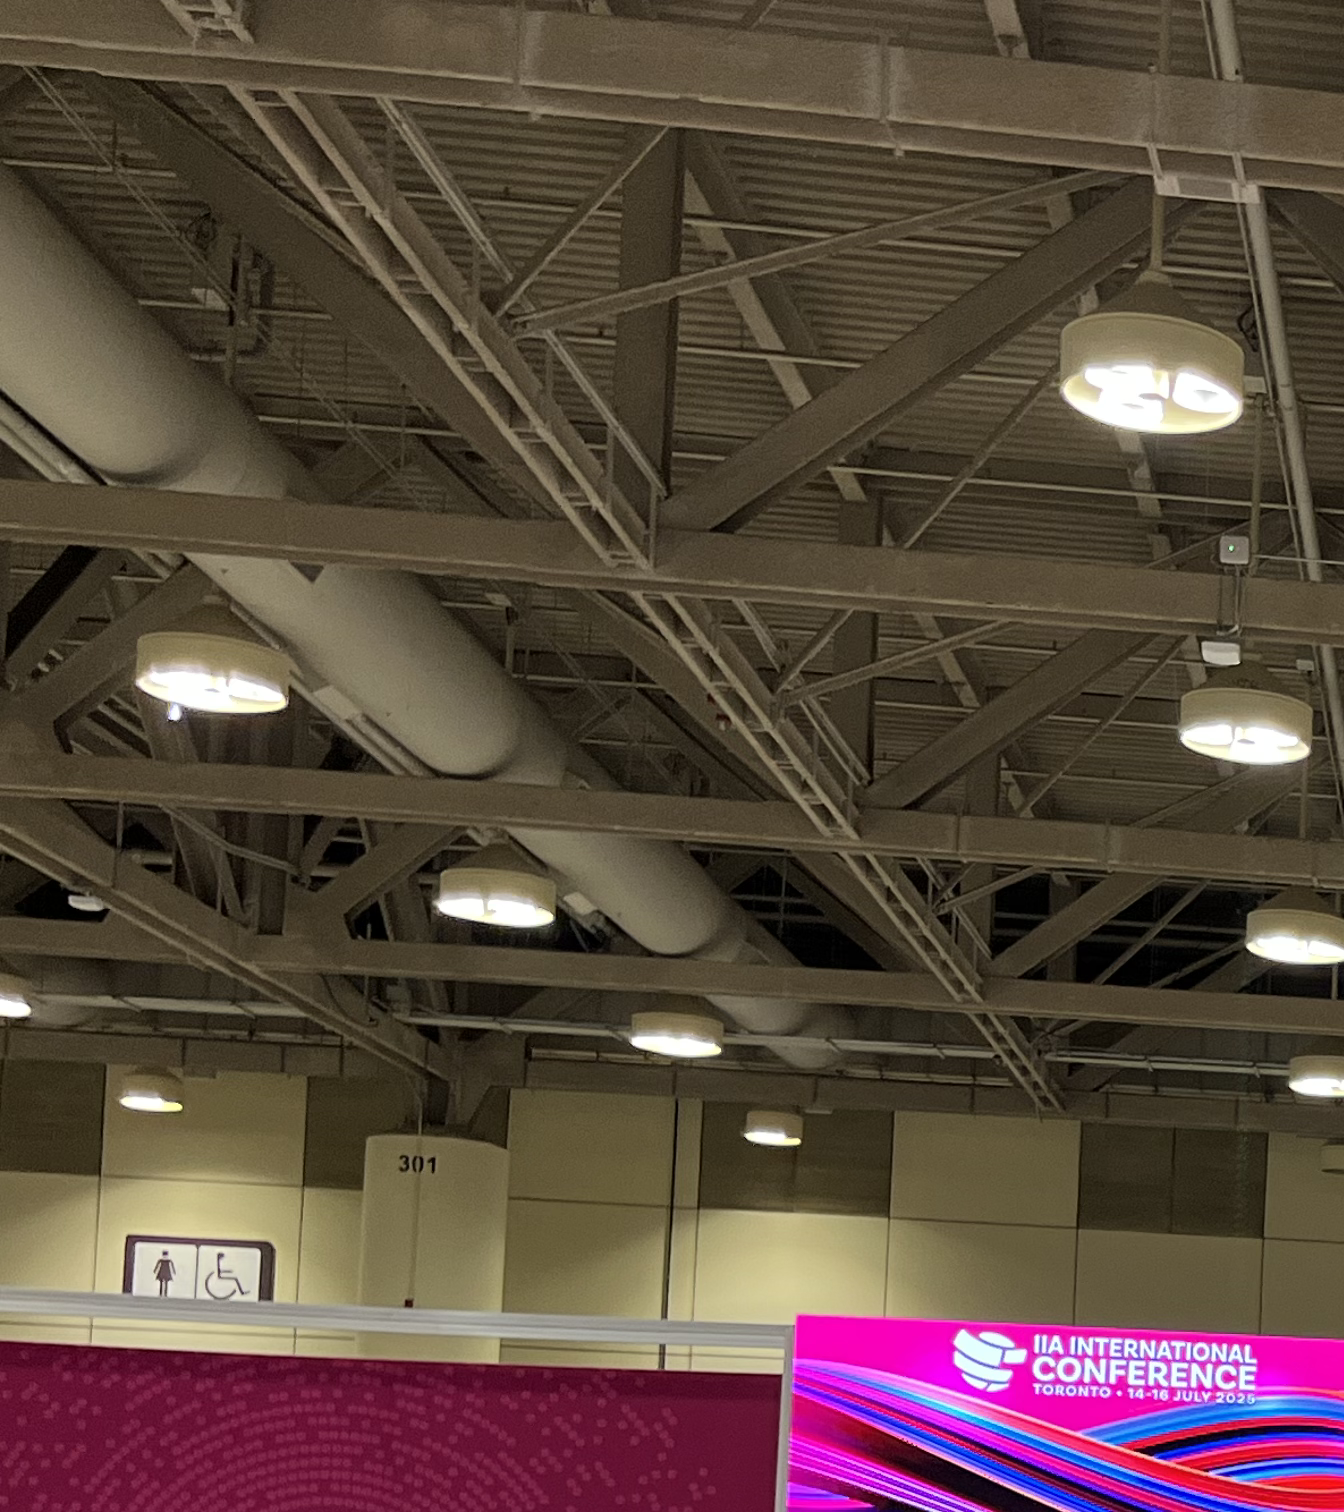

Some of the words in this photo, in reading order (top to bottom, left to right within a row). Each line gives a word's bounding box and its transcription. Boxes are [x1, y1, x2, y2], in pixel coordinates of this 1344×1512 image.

[399, 1155, 436, 1174] 301
[1033, 1334, 1064, 1354] IIA
[1069, 1336, 1257, 1364] INTERNATIONAL
[1032, 1355, 1257, 1390] CONFERENCE
[1033, 1383, 1111, 1398] TORONTO
[1127, 1387, 1169, 1401] 14-16
[1173, 1389, 1211, 1403] JULY
[1215, 1391, 1256, 1405] 2025
